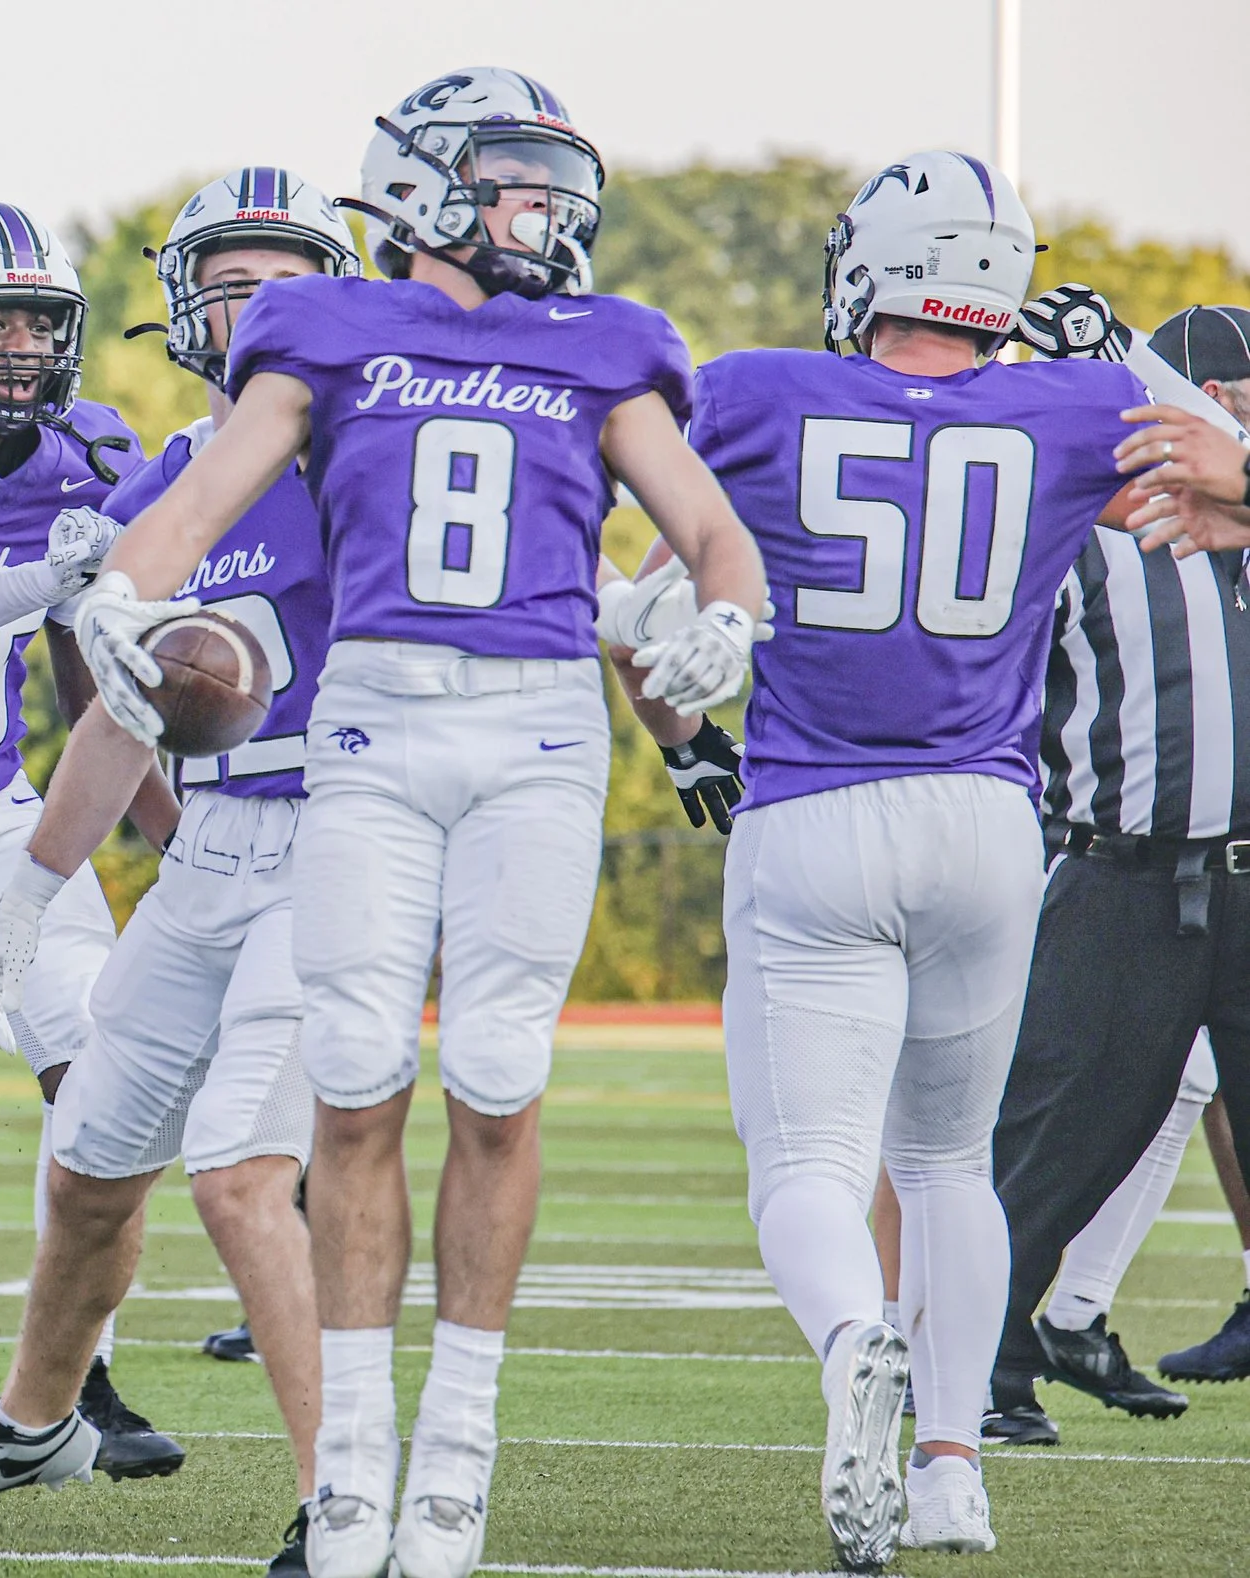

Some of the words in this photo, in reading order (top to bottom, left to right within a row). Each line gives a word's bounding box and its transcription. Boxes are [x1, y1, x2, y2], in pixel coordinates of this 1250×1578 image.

[235, 210, 289, 221] Riddell
[7, 272, 52, 284] Riddell
[905, 264, 923, 279] 50
[922, 298, 1011, 329] Riddell
[1079, 315, 1092, 342] adidas
[356, 355, 577, 422] Panthers
[406, 416, 516, 609] 8
[795, 415, 1036, 639] 50
